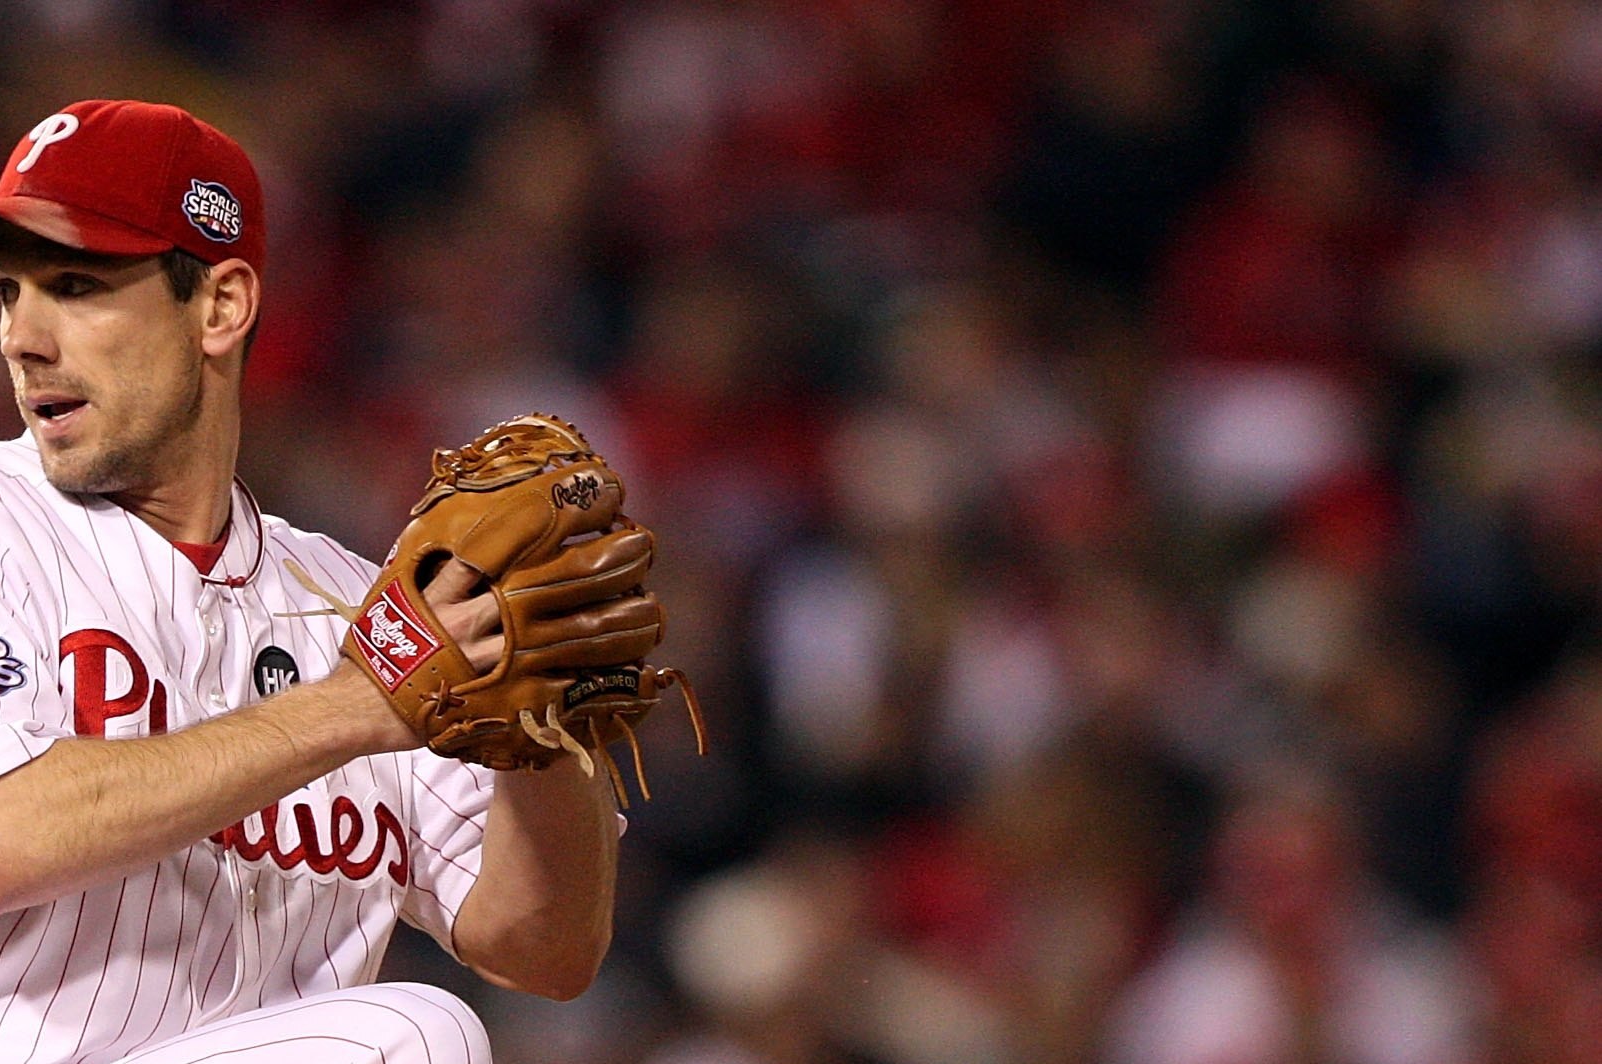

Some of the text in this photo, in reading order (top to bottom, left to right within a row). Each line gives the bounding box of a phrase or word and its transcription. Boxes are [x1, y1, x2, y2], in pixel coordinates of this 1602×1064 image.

[16, 113, 80, 174] P
[187, 195, 240, 236] SERIES
[196, 184, 239, 216] WORLD
[551, 474, 600, 509] Rawlings
[366, 600, 419, 657] Rawlings
[262, 666, 295, 695] HK
